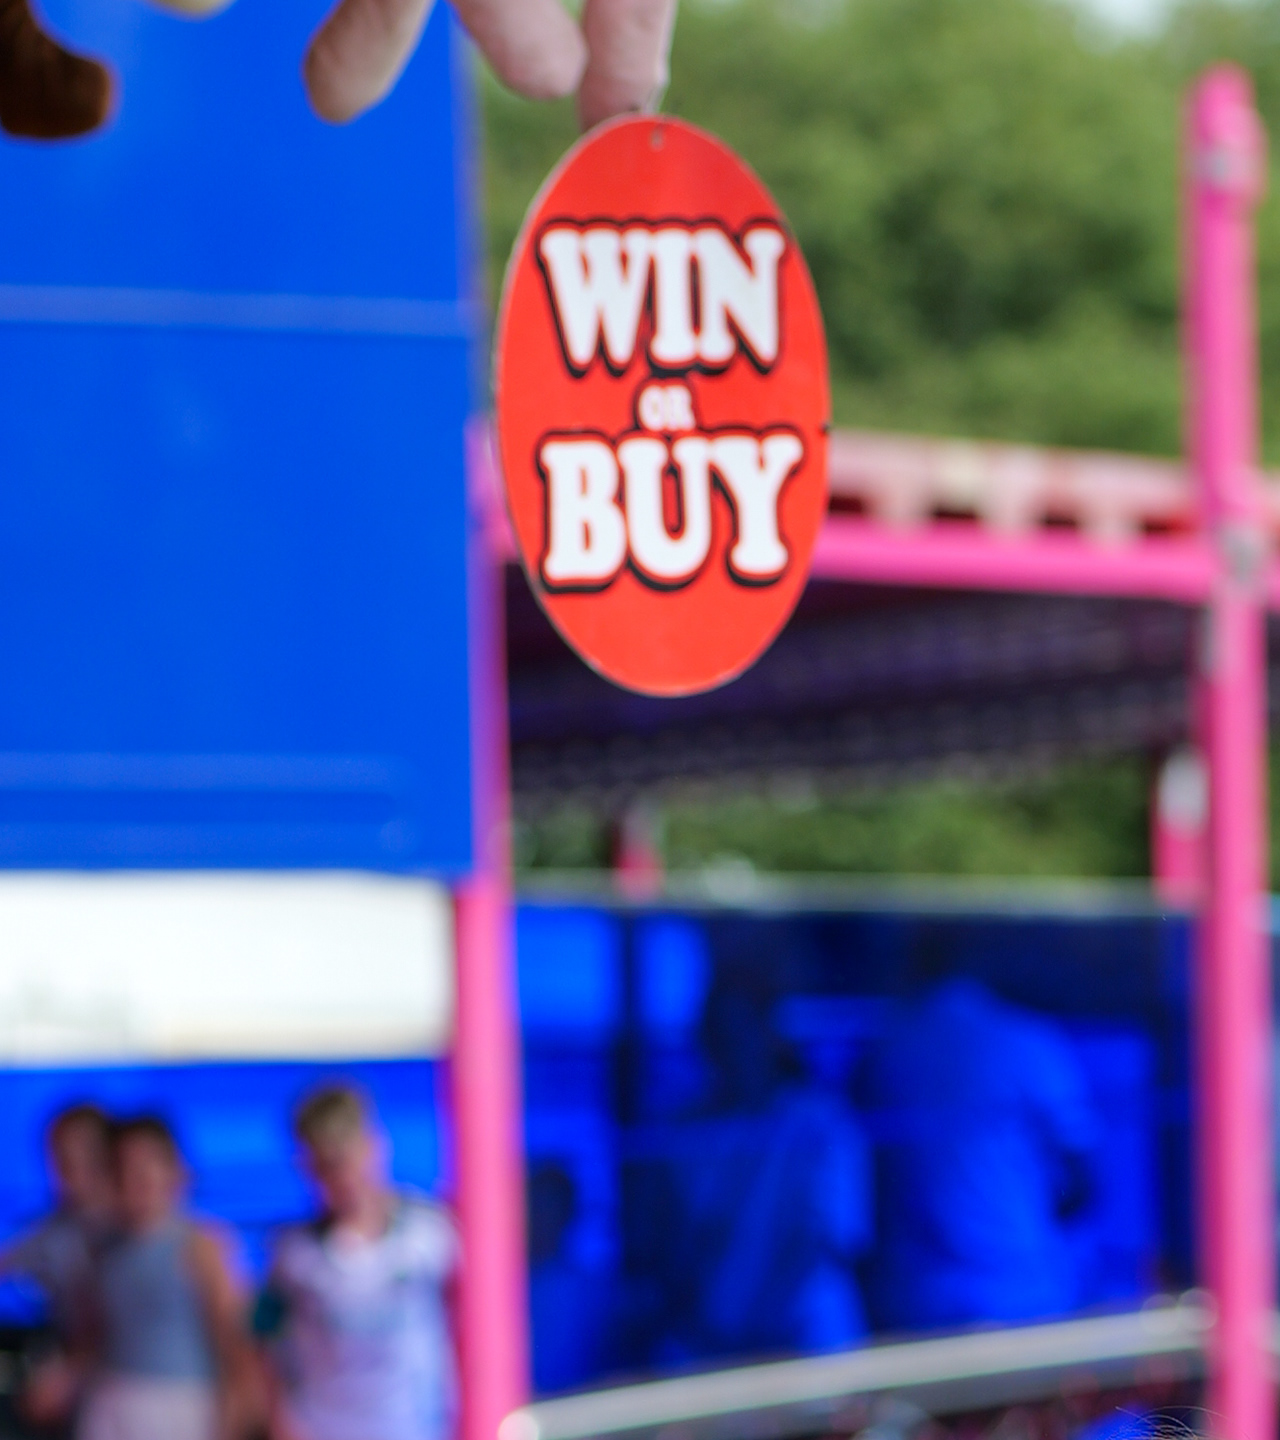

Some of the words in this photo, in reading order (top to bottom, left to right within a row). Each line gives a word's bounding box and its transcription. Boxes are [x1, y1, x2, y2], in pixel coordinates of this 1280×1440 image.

[537, 223, 789, 372] WIN
[638, 384, 695, 433] OR
[539, 433, 804, 584] BUY
